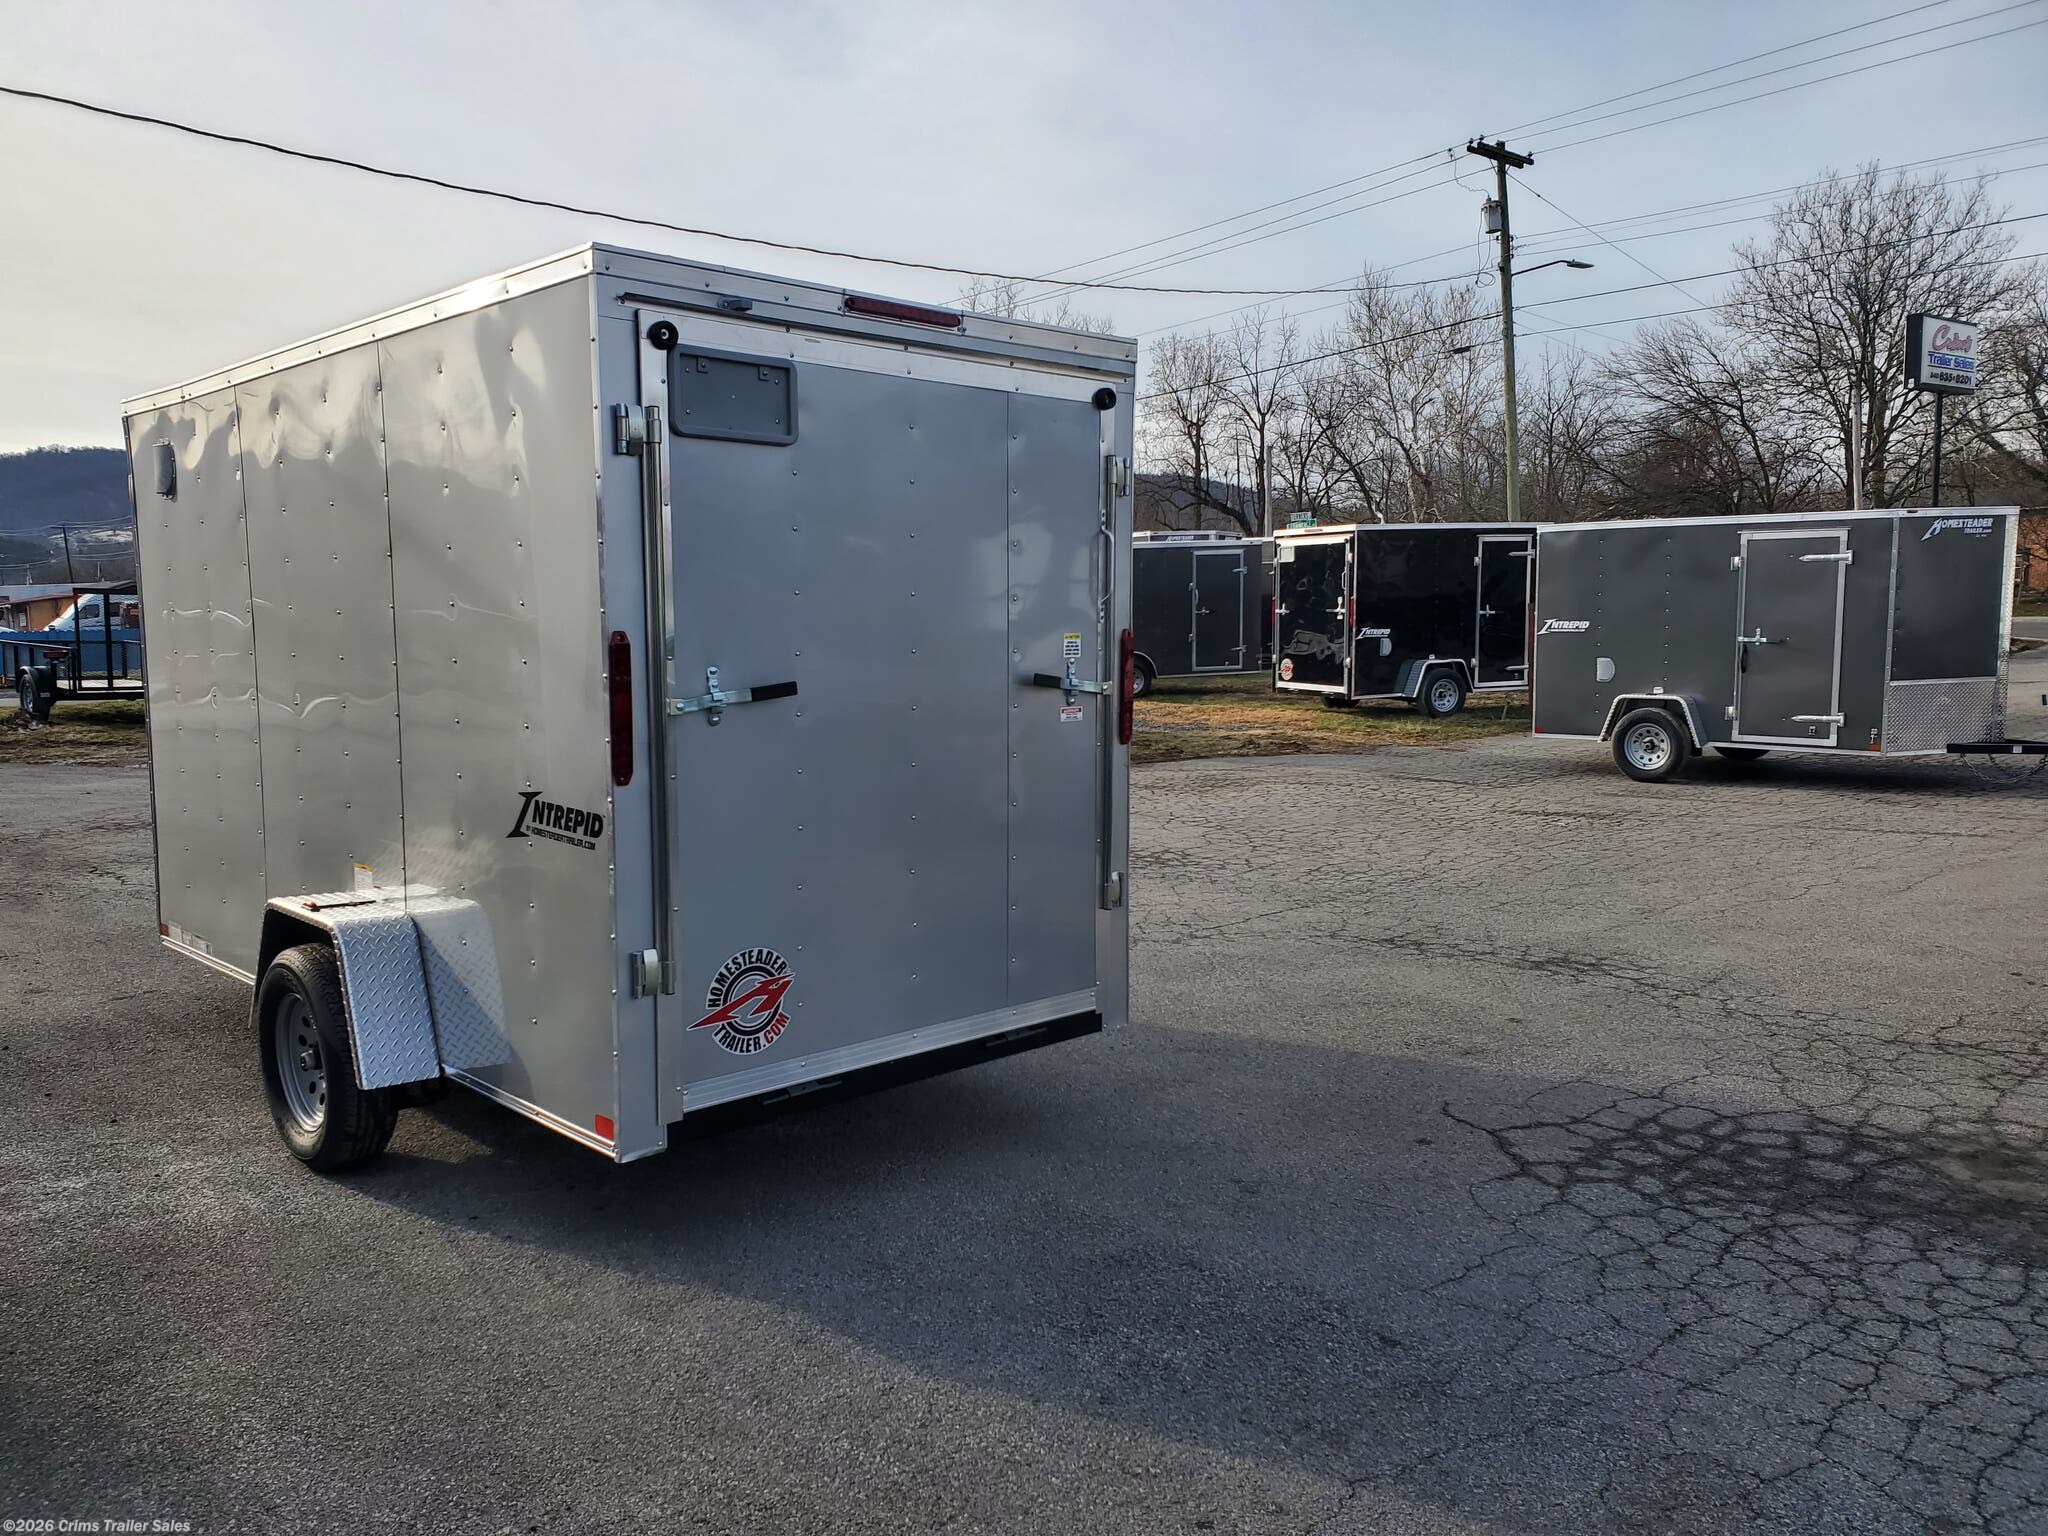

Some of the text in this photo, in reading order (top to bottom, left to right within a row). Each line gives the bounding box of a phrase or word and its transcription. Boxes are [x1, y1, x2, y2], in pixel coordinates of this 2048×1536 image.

[1928, 353, 1975, 370] Trailer Sales
[1920, 517, 1994, 541] HOMESTEADER
[1537, 618, 1591, 635] INTREPID
[506, 791, 604, 839] INTREPID
[707, 948, 788, 1009] HOMESTEADER
